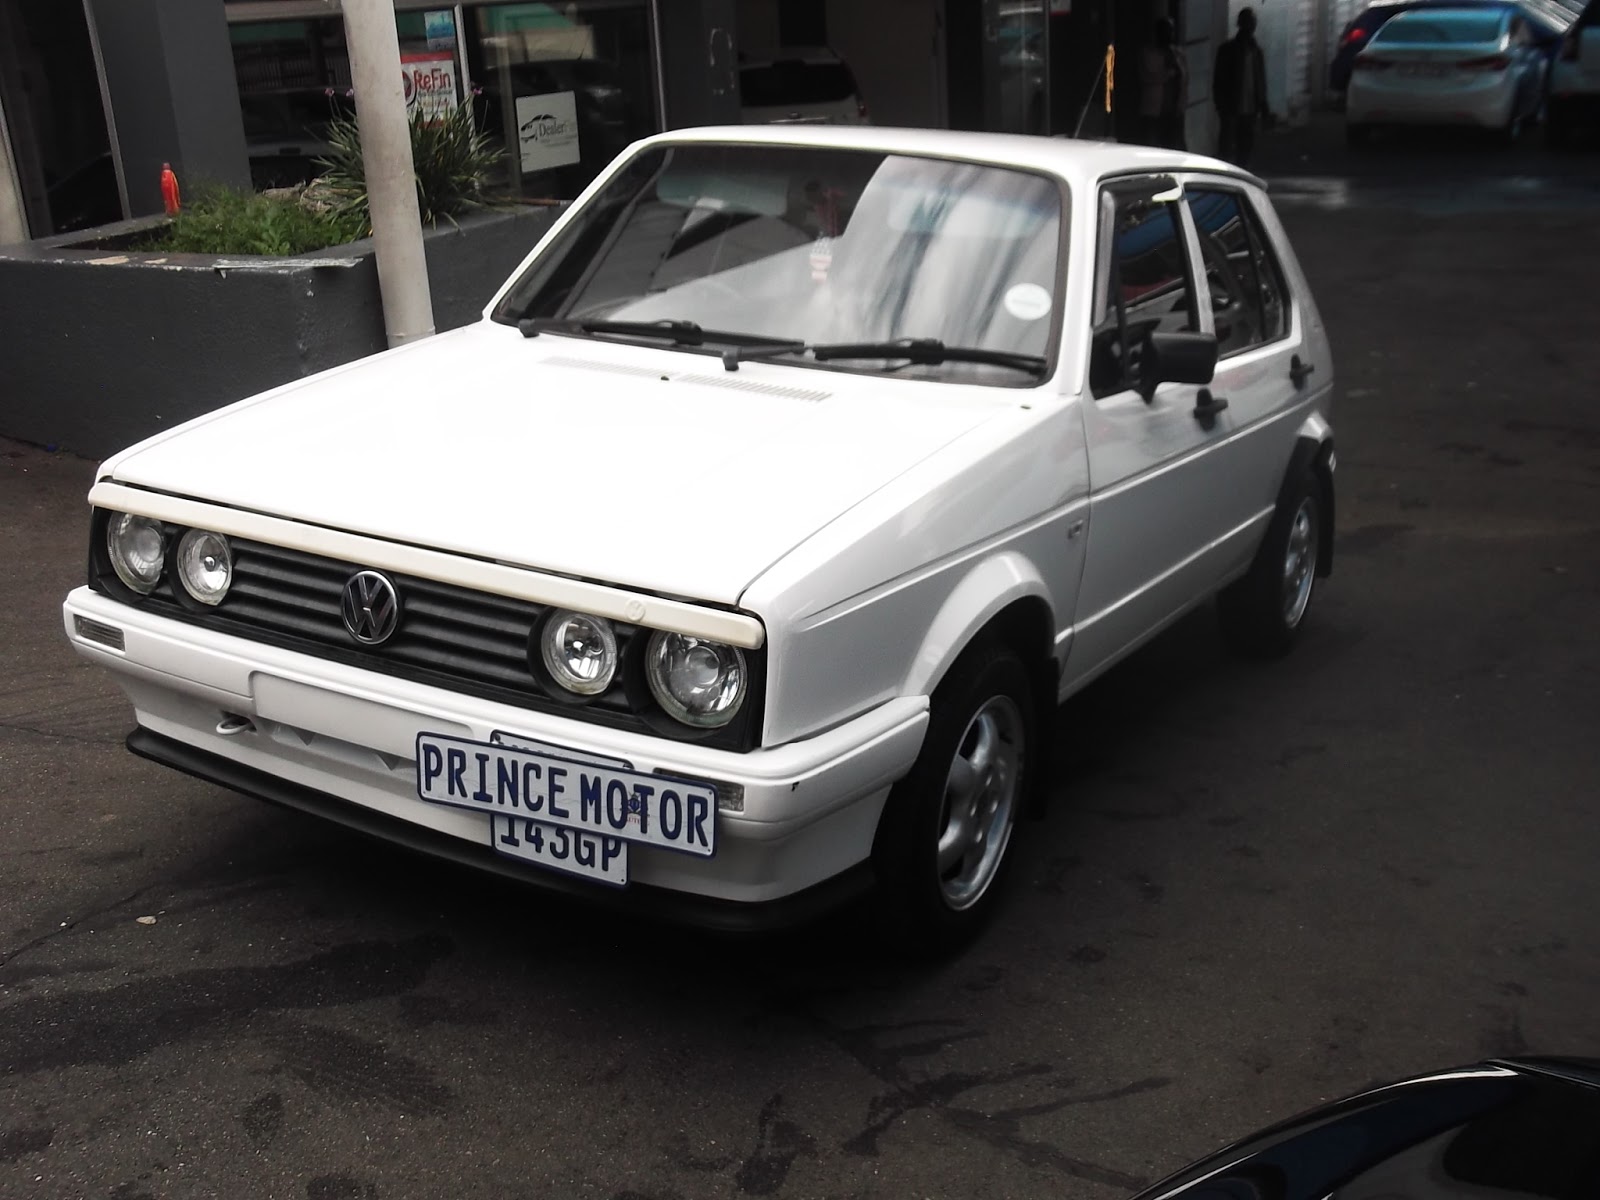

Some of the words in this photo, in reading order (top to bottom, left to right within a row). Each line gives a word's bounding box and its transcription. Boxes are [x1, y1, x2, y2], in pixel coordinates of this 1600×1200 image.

[414, 68, 451, 90] ReFin
[423, 743, 569, 818] PRINCE
[580, 773, 709, 847] MOTOR
